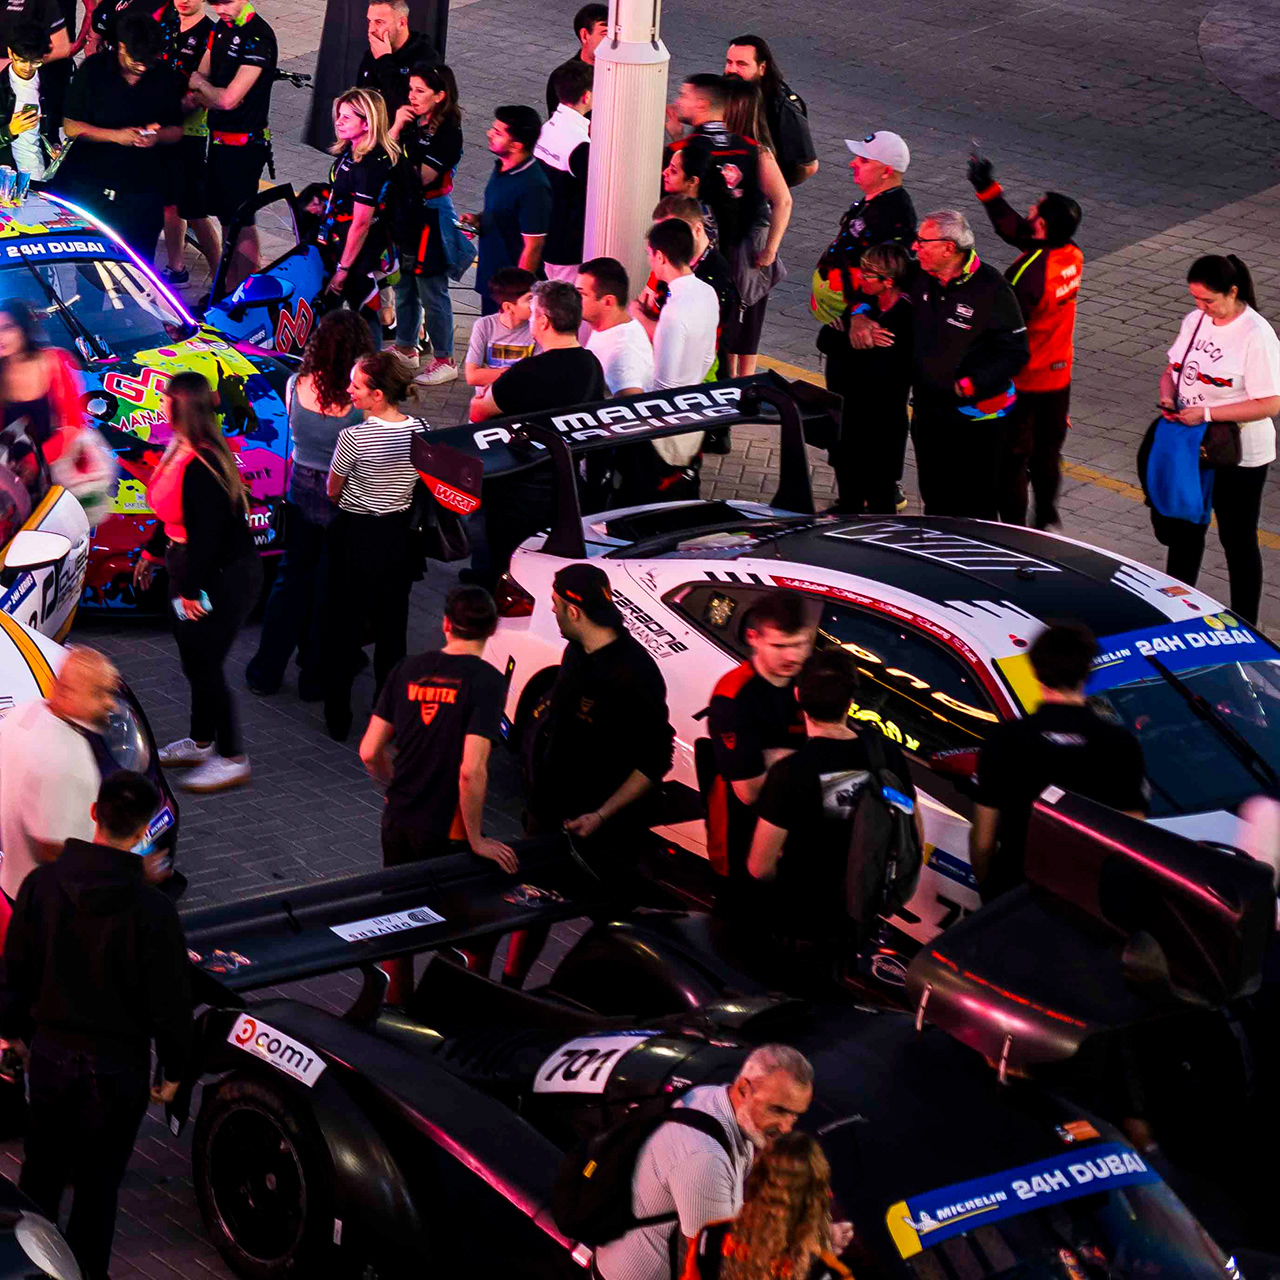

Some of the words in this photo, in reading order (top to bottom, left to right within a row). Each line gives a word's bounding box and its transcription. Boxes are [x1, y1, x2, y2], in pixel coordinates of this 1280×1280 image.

[6, 244, 46, 258] 24H
[51, 241, 106, 255] DUBAI
[551, 386, 744, 430] MANAR
[1092, 647, 1131, 668] HELIN
[1135, 633, 1183, 658] 24H
[1186, 626, 1255, 651] DUBAI
[543, 1049, 621, 1083] 701
[935, 1190, 1008, 1223] MICHELIN
[1012, 1170, 1070, 1202] 24H
[1069, 1153, 1147, 1187] DUBAI
